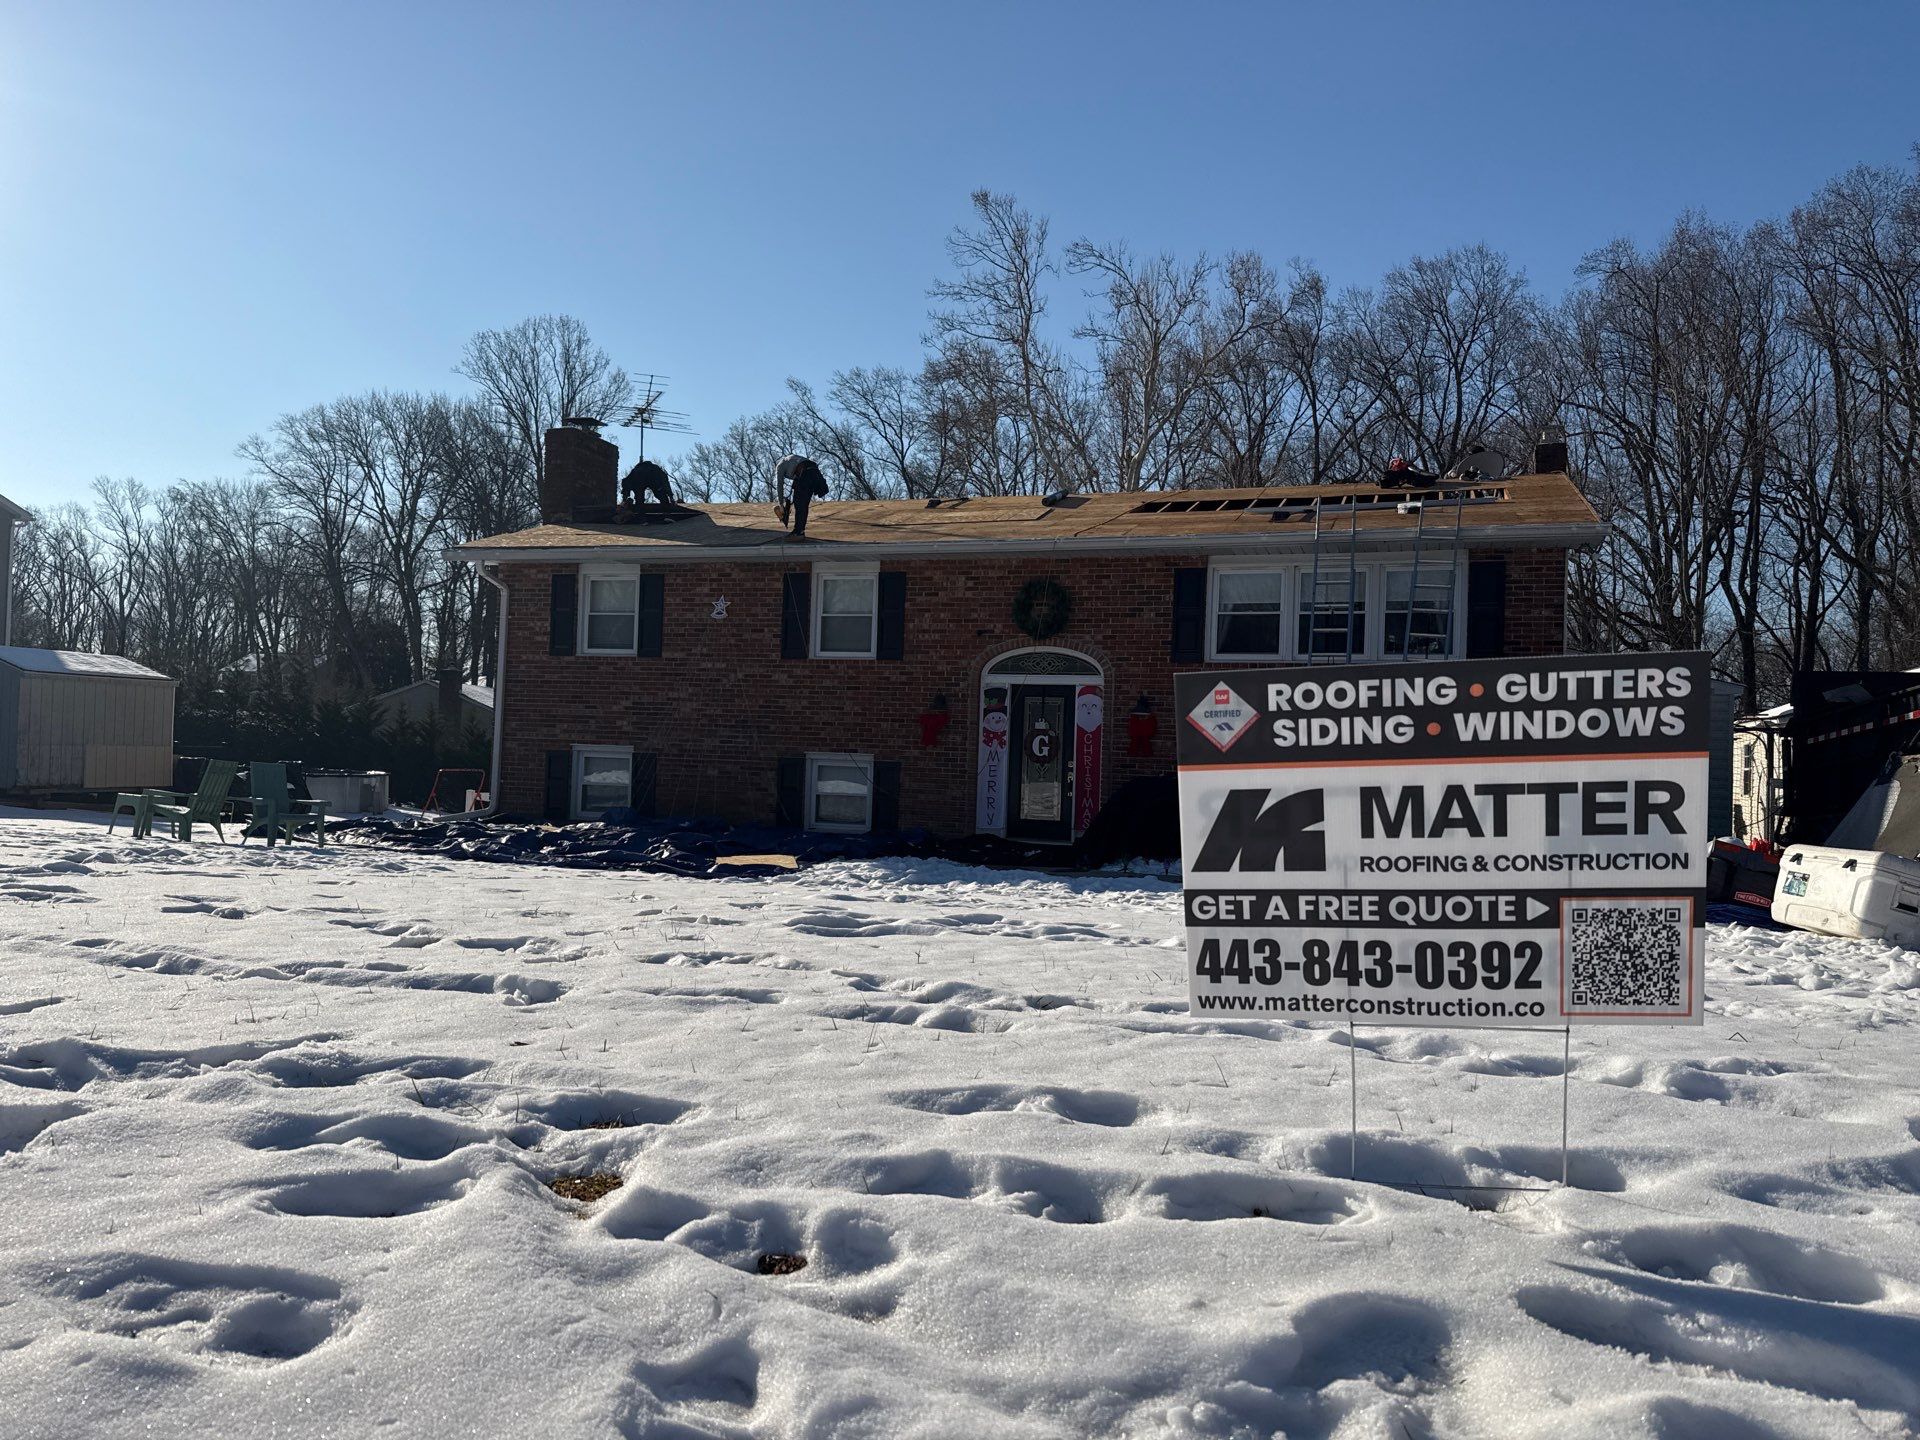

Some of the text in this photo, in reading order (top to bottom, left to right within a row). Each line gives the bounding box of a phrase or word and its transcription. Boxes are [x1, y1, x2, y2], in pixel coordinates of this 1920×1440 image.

[1267, 666, 1692, 712] ROOFING GUTTERS
[1203, 709, 1242, 719] CERTIFIED
[1272, 714, 1415, 748] SIDING
[1453, 705, 1686, 742] WINDOWS
[1032, 735, 1050, 757] G
[987, 750, 1000, 825] MERRY
[1082, 733, 1094, 829] CHRISTMAS
[1359, 780, 1688, 839] MATTER
[1359, 852, 1689, 873] ROOFING & CONSTRUCTION
[1191, 895, 1517, 926] GET A FREE QUOTE
[1195, 938, 1543, 991] 443-843-0392
[1197, 993, 1546, 1018] www.matterconstruction.co
